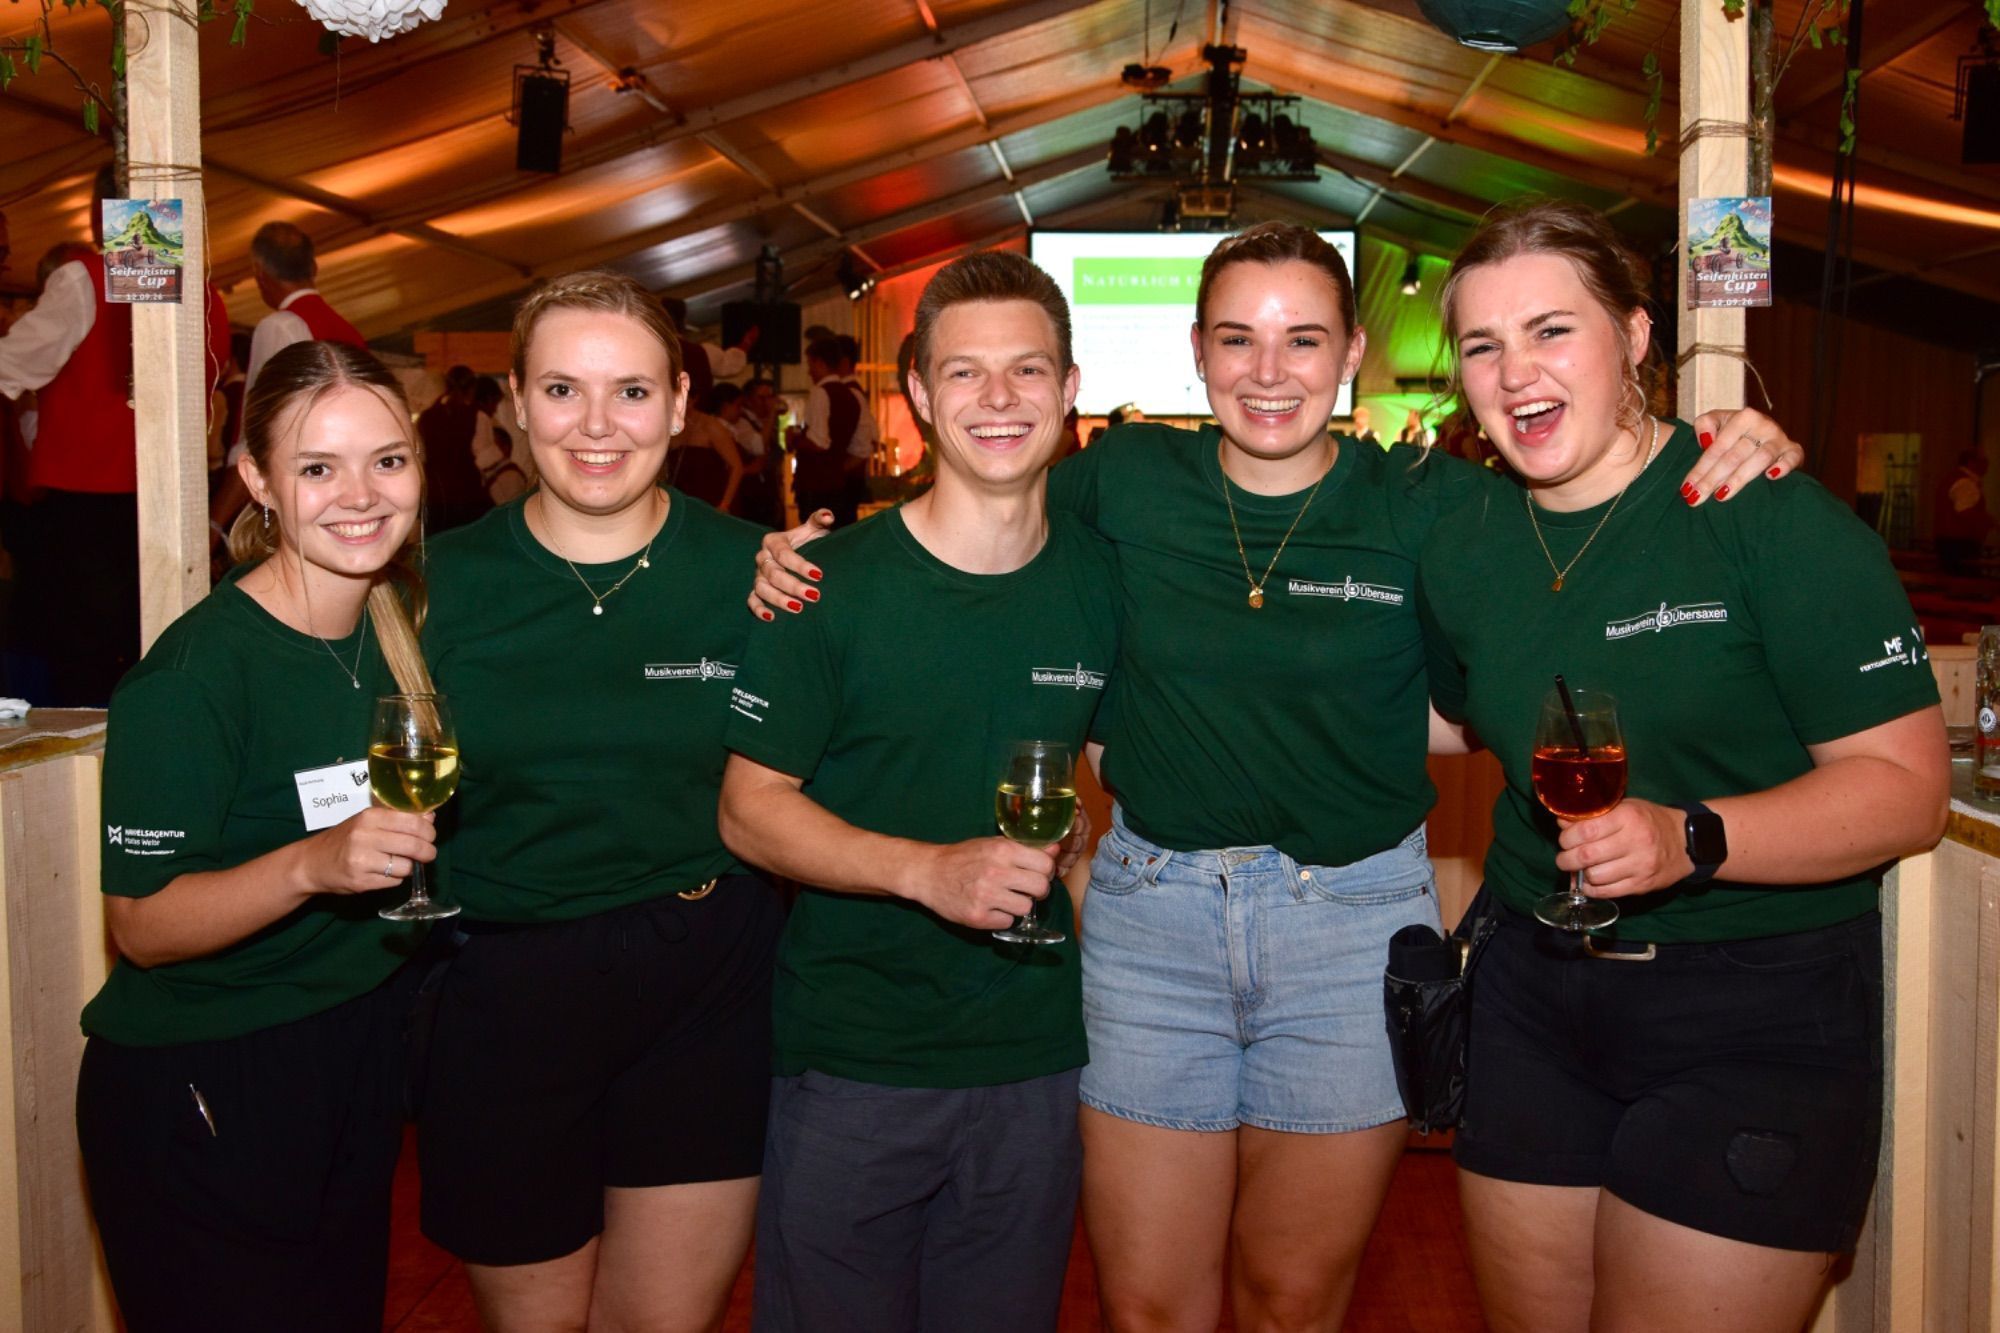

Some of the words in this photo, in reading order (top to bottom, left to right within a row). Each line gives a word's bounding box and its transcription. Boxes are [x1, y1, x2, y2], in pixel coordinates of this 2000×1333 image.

[110, 267, 176, 276] Seifenkisten
[1696, 272, 1768, 281] Seifenkisten
[138, 275, 167, 288] Cup
[1724, 280, 1757, 293] Cup
[1288, 582, 1343, 595] Musikverein
[1360, 585, 1404, 602] Übersaxen
[1672, 607, 1728, 622] Übersaxen
[644, 666, 700, 677] Musikverein
[1031, 671, 1076, 684] Musikverein
[311, 792, 350, 809] Sophia
